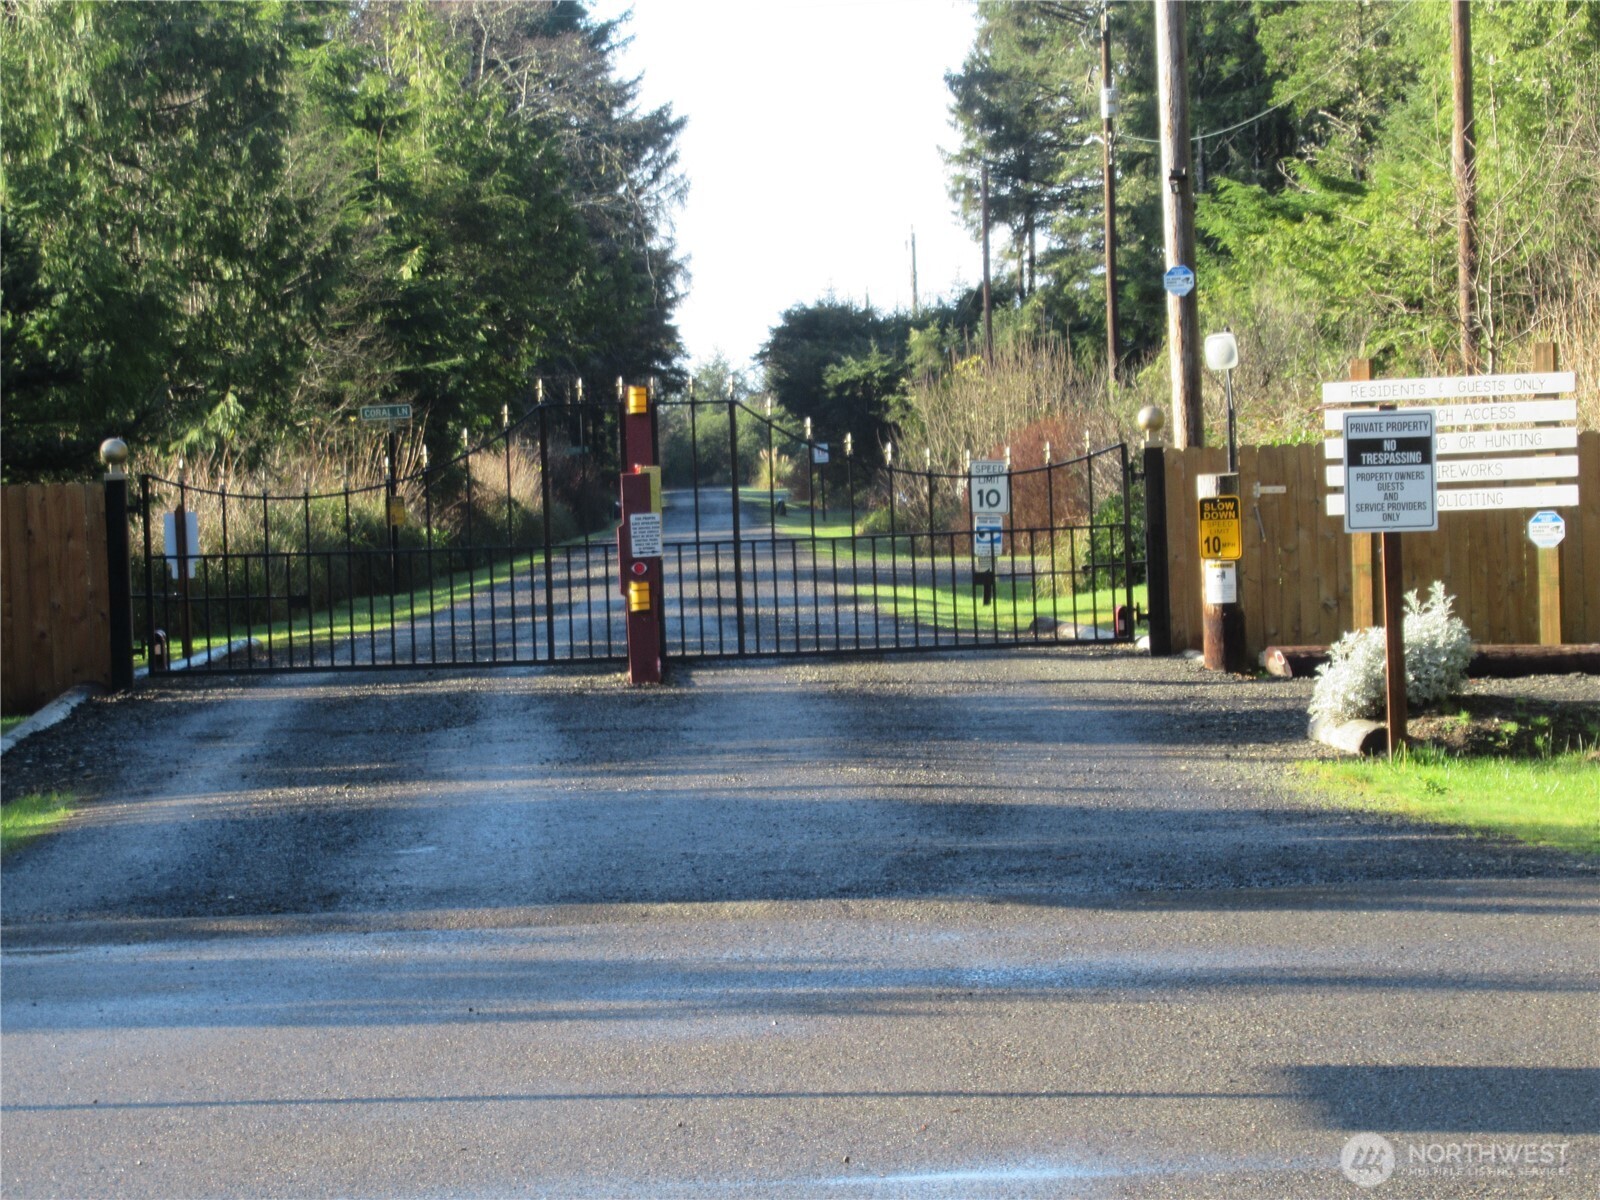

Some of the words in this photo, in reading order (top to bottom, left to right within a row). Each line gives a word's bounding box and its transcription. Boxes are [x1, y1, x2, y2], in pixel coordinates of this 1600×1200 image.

[1351, 384, 1426, 398] RESIDENTS
[1458, 380, 1506, 393] GUESTS
[1514, 378, 1546, 391] ONLY
[396, 407, 408, 416] LN
[1464, 406, 1516, 421] ACCESS
[1350, 422, 1384, 433] PRIVATE
[1386, 420, 1429, 432] PROPERTY
[1383, 439, 1397, 451] NO
[1459, 435, 1476, 449] OR
[1485, 432, 1542, 448] HUNTING
[1361, 451, 1422, 465] TRESPASSING
[975, 464, 1004, 473] SPEED
[1437, 462, 1504, 479] IREWORKS
[978, 475, 999, 485] LIMIT
[1356, 472, 1393, 482] PROPERTY
[1394, 471, 1425, 480] OWNERS
[1377, 481, 1405, 491] GUESTS
[977, 488, 1001, 508] 10
[1383, 492, 1399, 501] AND
[1437, 492, 1504, 507] OLICITING
[1203, 502, 1235, 511] SLOW
[1355, 503, 1385, 513] SERVICE
[1387, 501, 1427, 511] PROVIDERS
[1203, 511, 1236, 520] DOWN
[1382, 512, 1400, 522] ONLY
[1206, 520, 1234, 528] SPEED
[1204, 535, 1221, 554] 10
